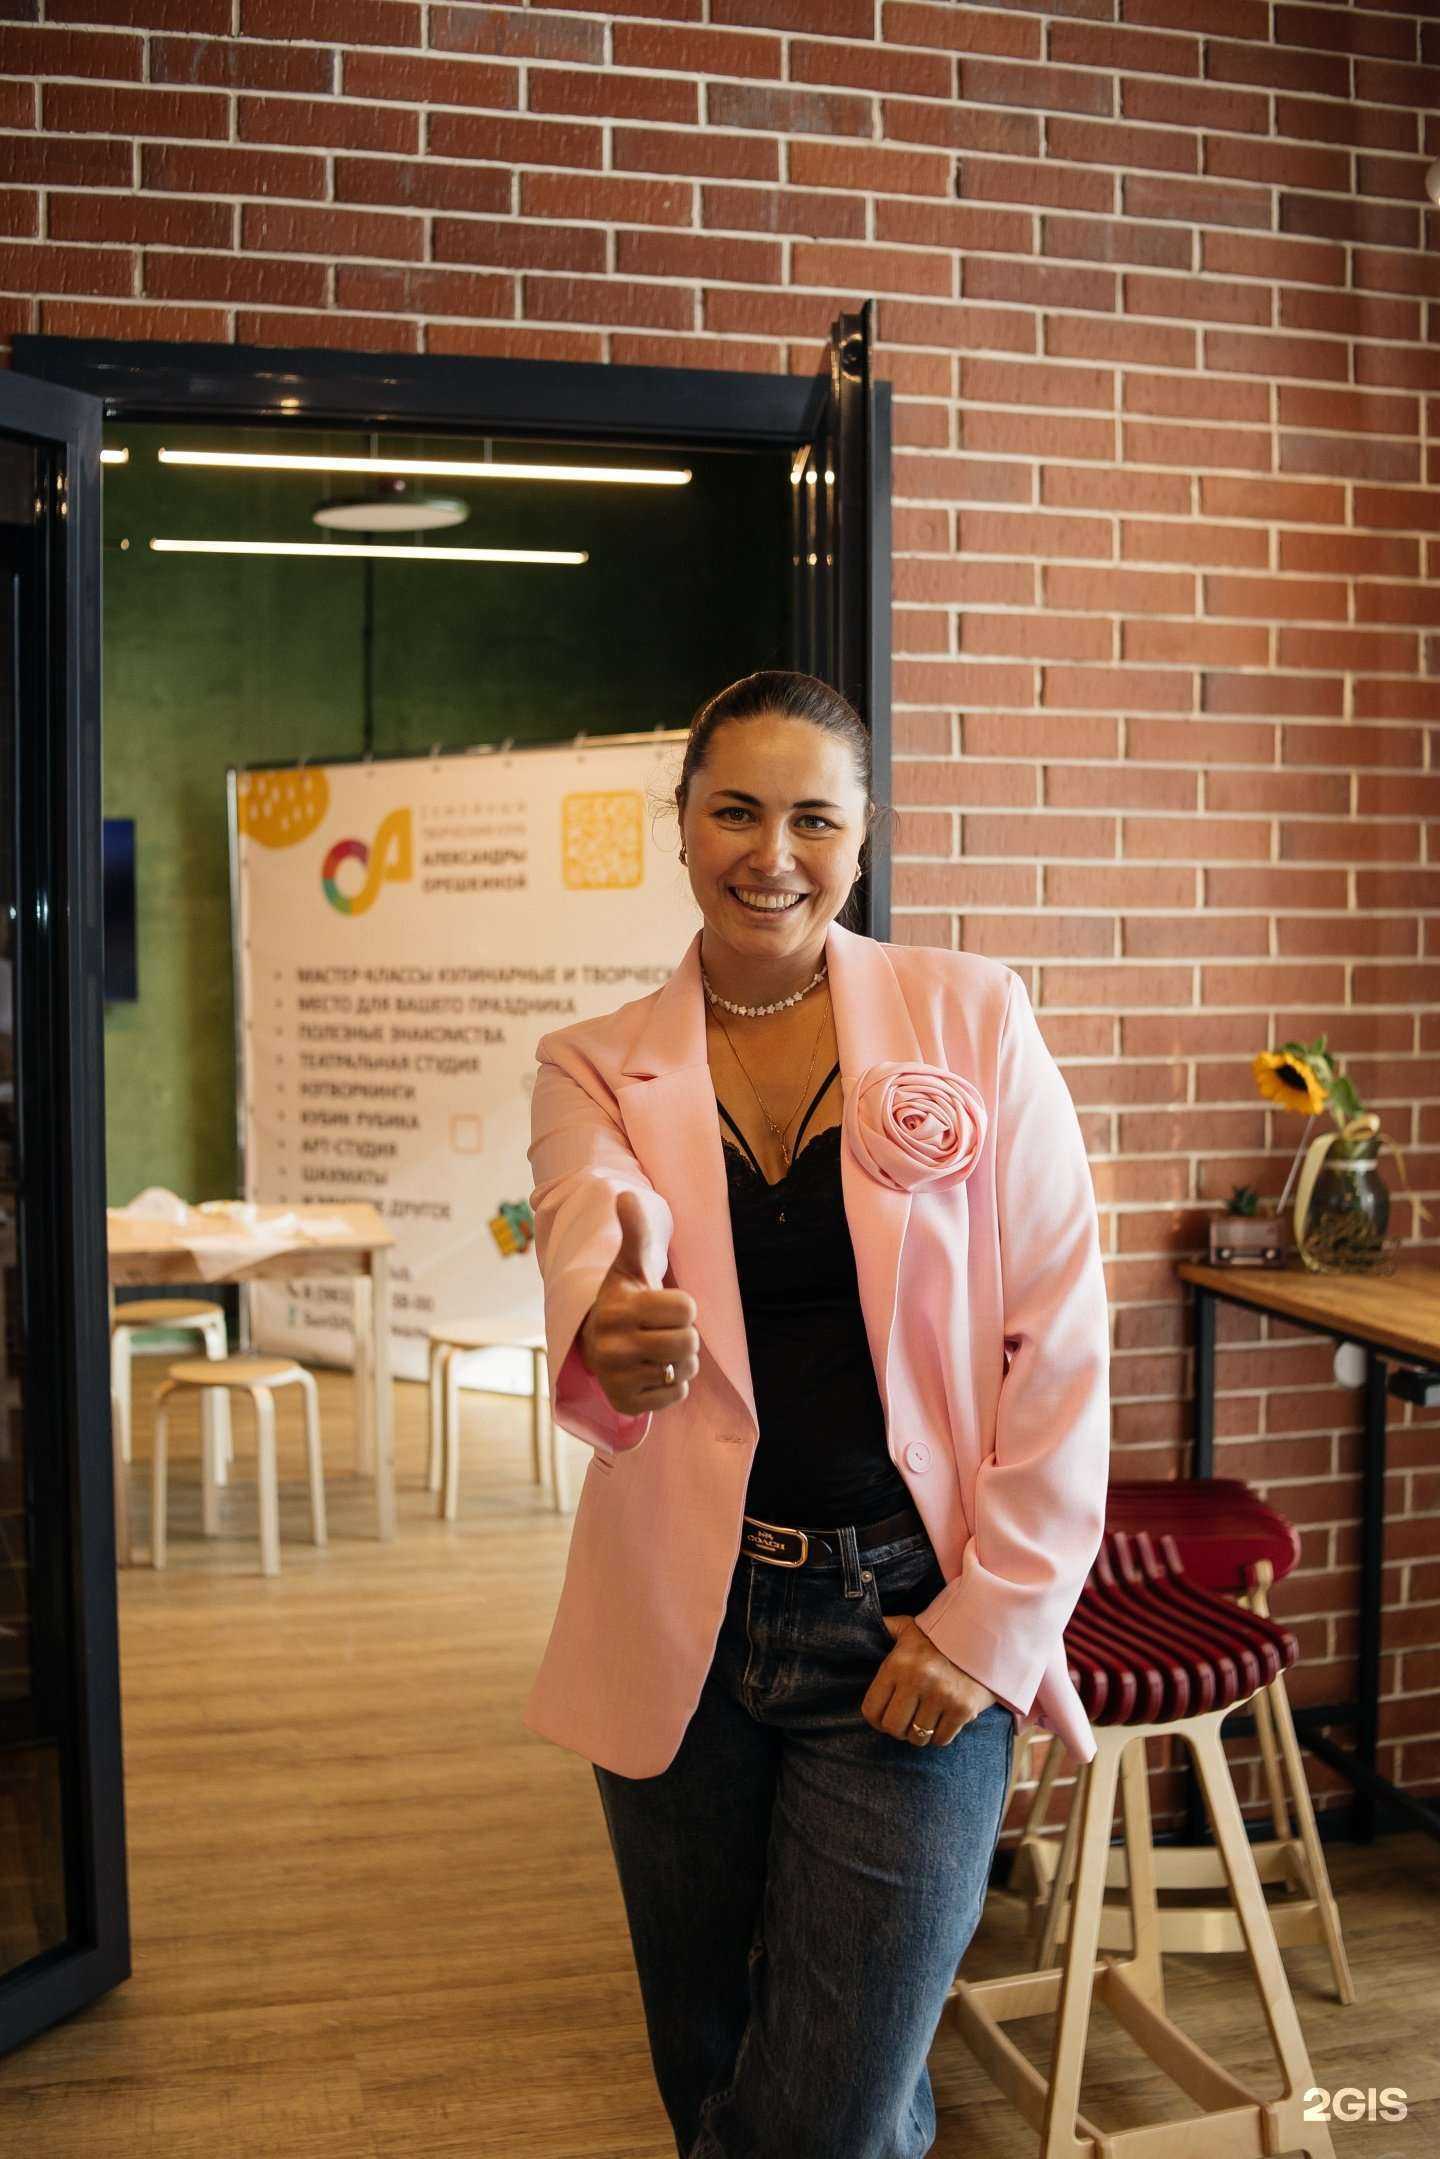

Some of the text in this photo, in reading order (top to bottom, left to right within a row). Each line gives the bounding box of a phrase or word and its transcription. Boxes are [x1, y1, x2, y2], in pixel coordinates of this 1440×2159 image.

[422, 849, 528, 867] АЛЕКСАНДРЫ
[438, 966, 555, 984] КУЛИНАРНЫЕ
[563, 966, 576, 983] И
[297, 997, 575, 1016] МЕСТО ДЛЯ ВАШЕГО ПРАЗДНИКА
[299, 1024, 505, 1045] ПОЛЕЗНЫЕ ЗНАКОМСТВА
[300, 1053, 480, 1074] ТЕАТРАЛЬНАЯ СТУДИЯ
[301, 1110, 420, 1130] КУБИК РУБИКА
[301, 1167, 388, 1185] ШАХМАТЫ
[390, 1199, 450, 1220] ДРУГОЕ
[747, 1535, 785, 1550] COACH
